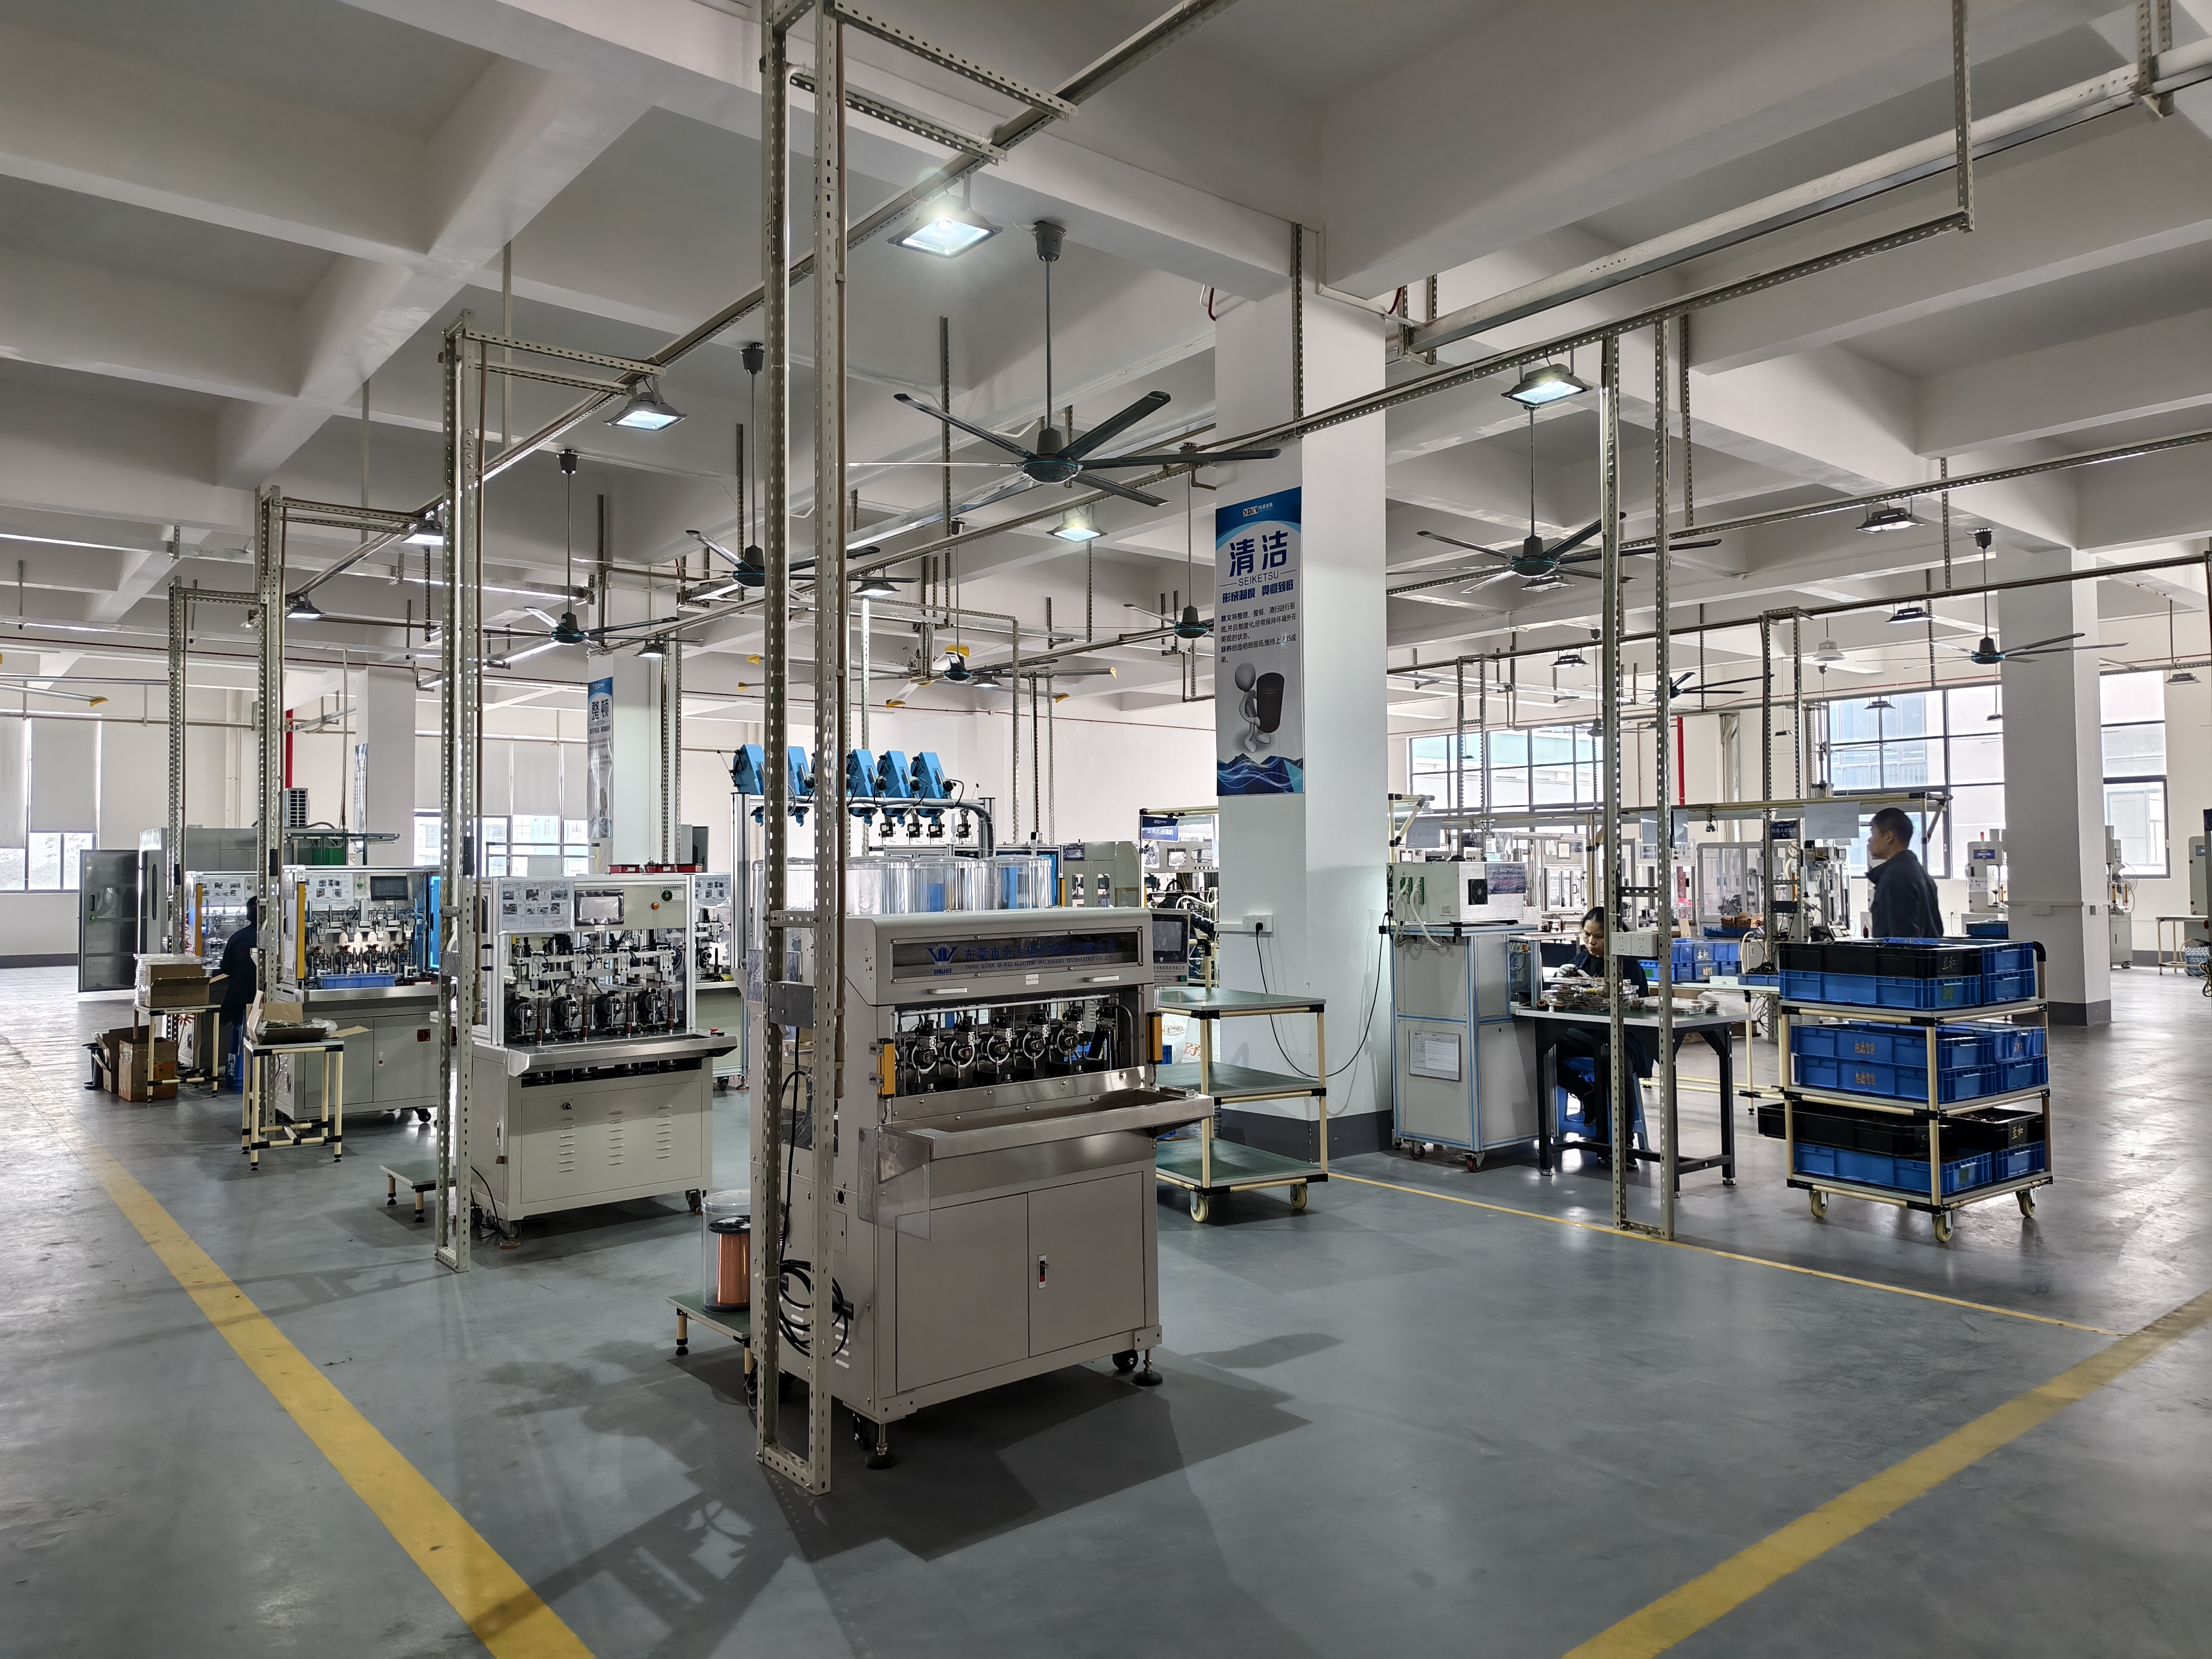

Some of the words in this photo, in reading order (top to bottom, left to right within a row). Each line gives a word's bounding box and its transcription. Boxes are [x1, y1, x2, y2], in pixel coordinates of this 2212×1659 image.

[1229, 530, 1288, 577] 清洁
[1238, 570, 1279, 586] SEIKETSU
[1223, 588, 1255, 603] 形成制度
[1262, 579, 1293, 596] 贯彻到底
[591, 699, 609, 720] 整顿
